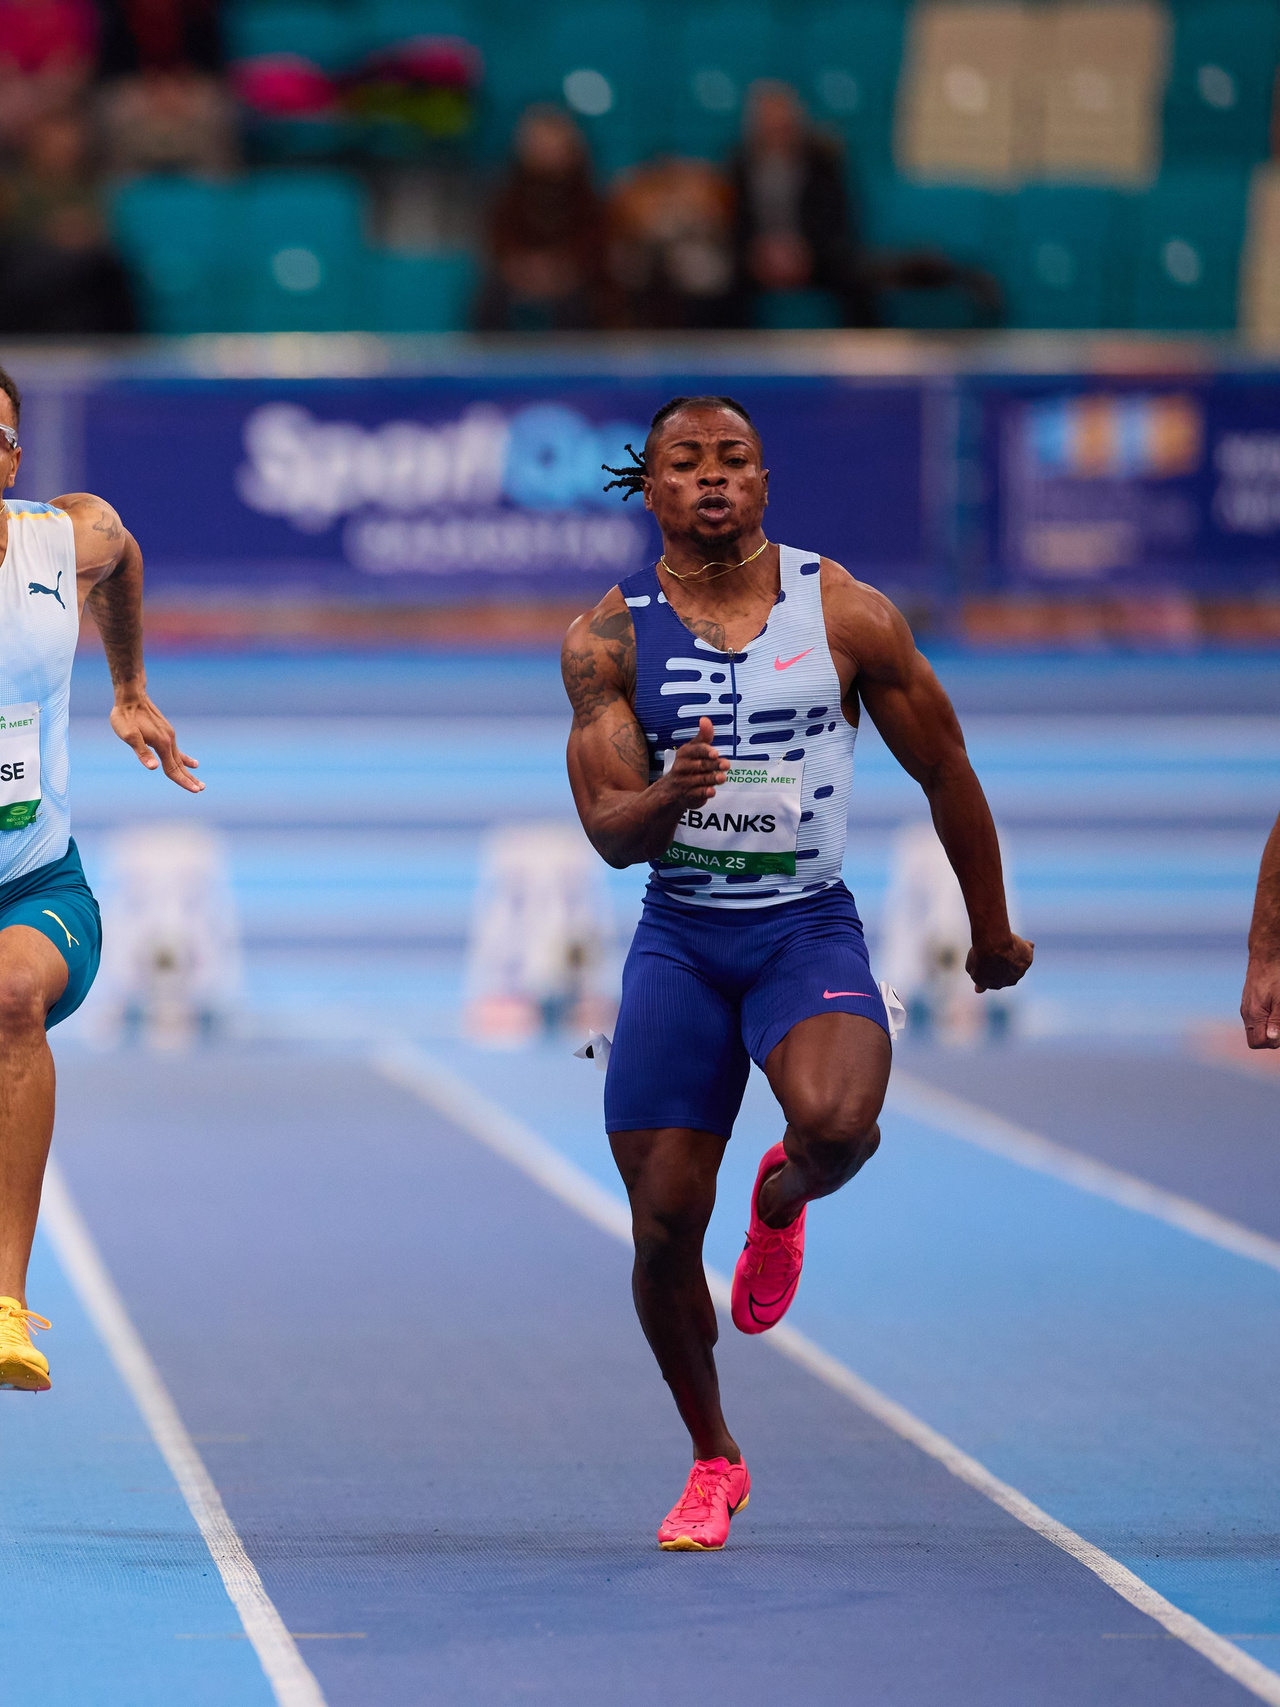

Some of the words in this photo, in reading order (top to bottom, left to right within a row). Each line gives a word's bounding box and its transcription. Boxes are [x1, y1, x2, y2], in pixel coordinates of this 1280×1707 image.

[9, 718, 34, 729] MEET
[726, 776, 768, 784] INDOOR
[770, 777, 797, 785] MEET
[679, 809, 776, 833] EBANKS
[725, 856, 746, 870] 25
